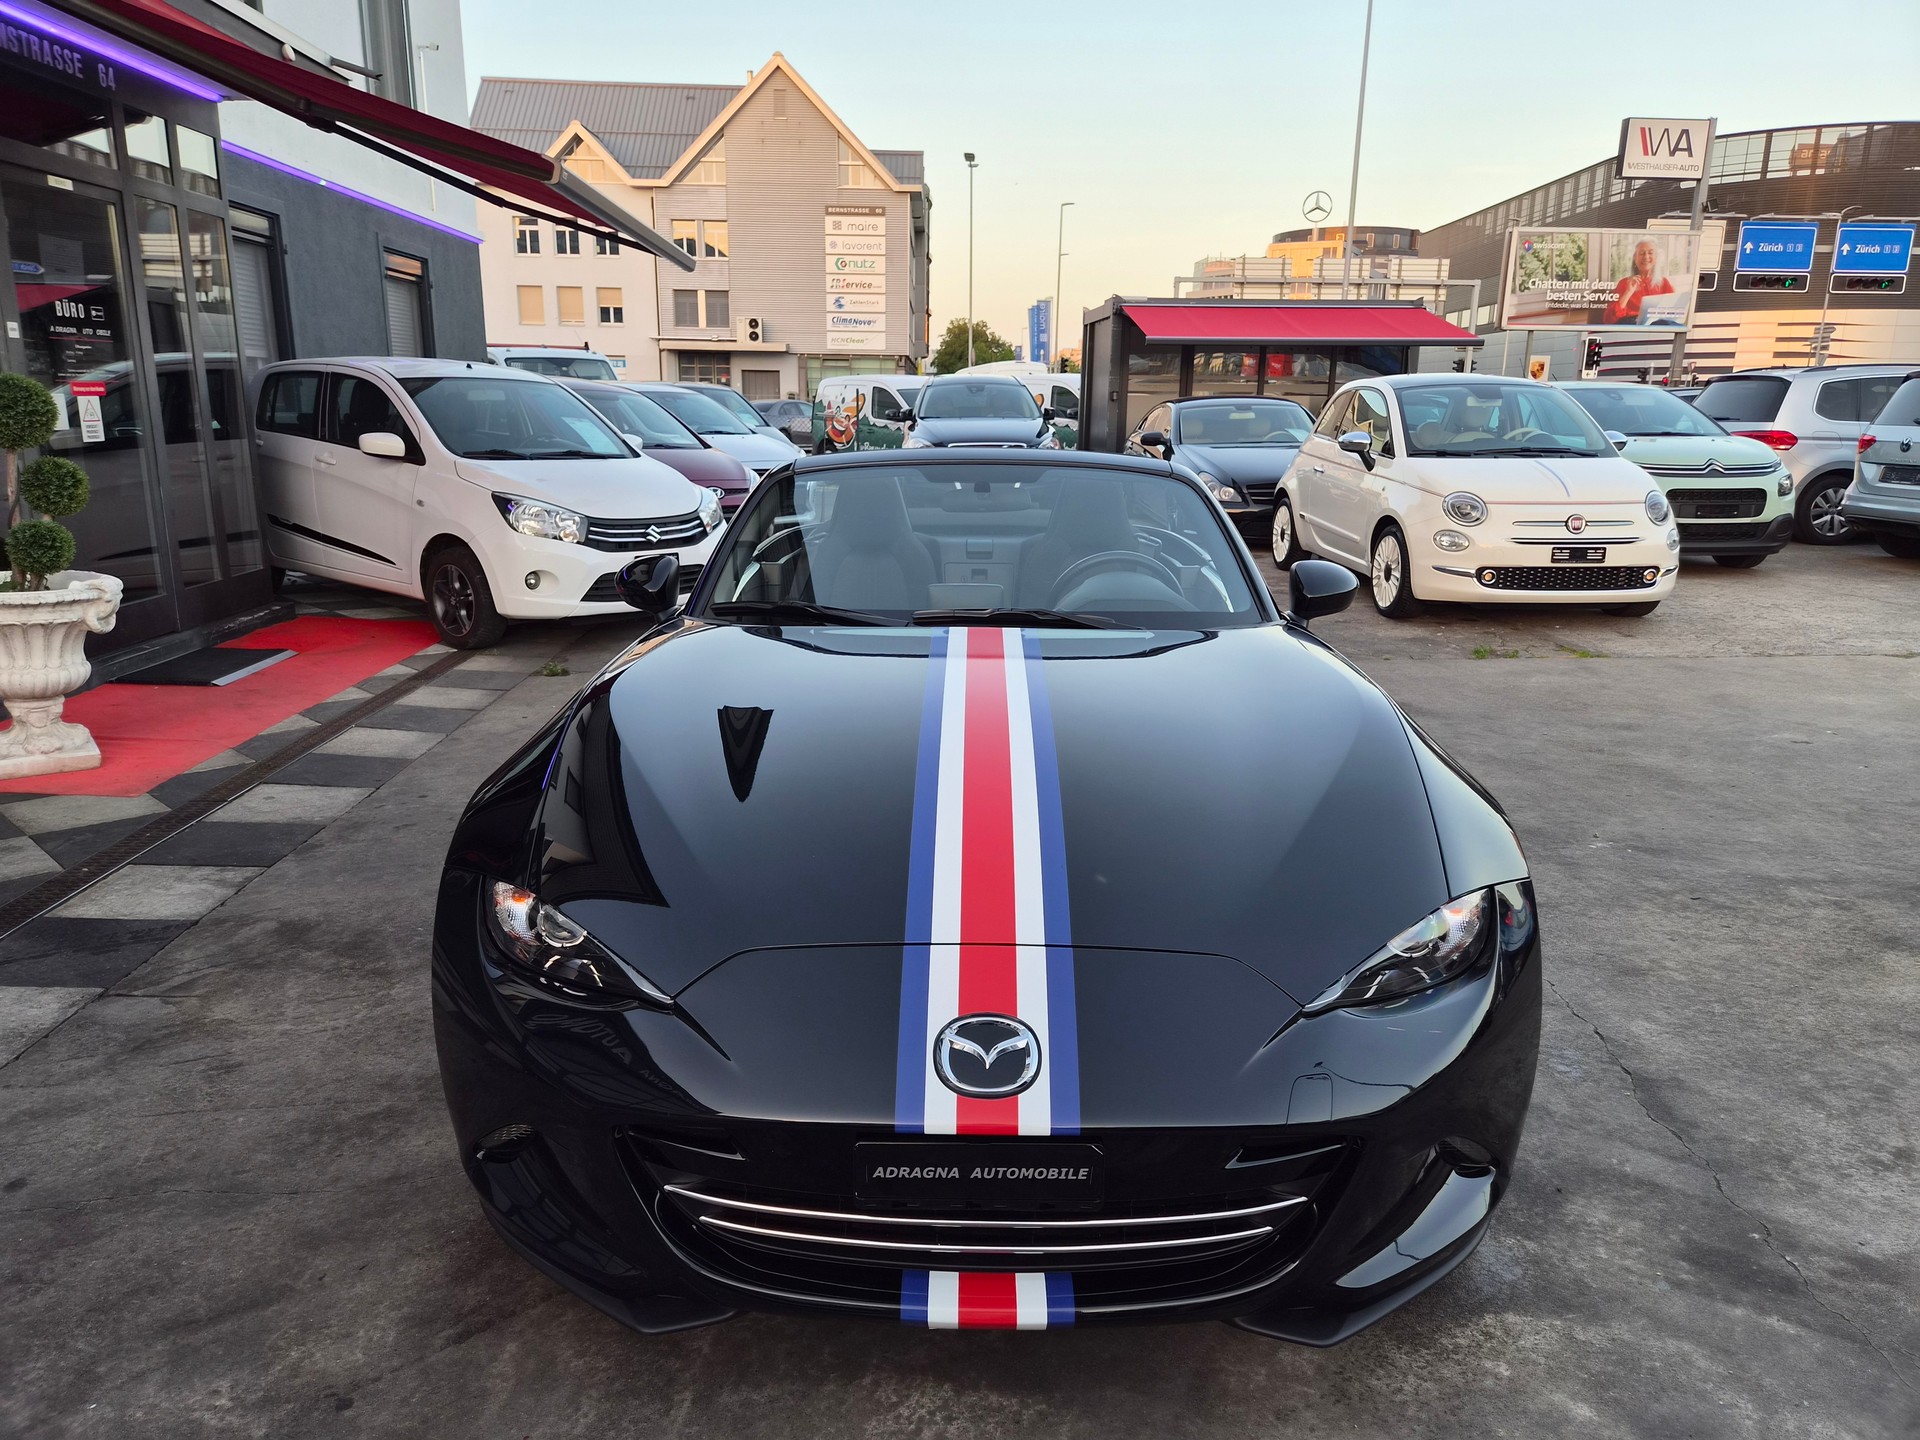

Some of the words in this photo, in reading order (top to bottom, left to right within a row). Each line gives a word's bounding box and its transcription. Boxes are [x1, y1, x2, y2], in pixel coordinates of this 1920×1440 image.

[97, 63, 116, 91] 64
[847, 220, 879, 231] maire
[841, 240, 883, 251] lavorent
[1533, 241, 1566, 249] swisscom
[1758, 242, 1784, 252] Zürich
[1855, 244, 1880, 253] Zürich
[848, 259, 876, 268] nutz
[1528, 278, 1569, 289] Chatten
[1571, 279, 1590, 289] mit
[1592, 279, 1616, 290] dem
[1546, 290, 1582, 301] besten
[1583, 291, 1620, 302] Service
[55, 299, 86, 319] BÜRO
[831, 316, 872, 326] ClimaNova
[872, 1166, 960, 1179] ADRAGNA
[969, 1167, 1090, 1180] AUTOMOBILE
